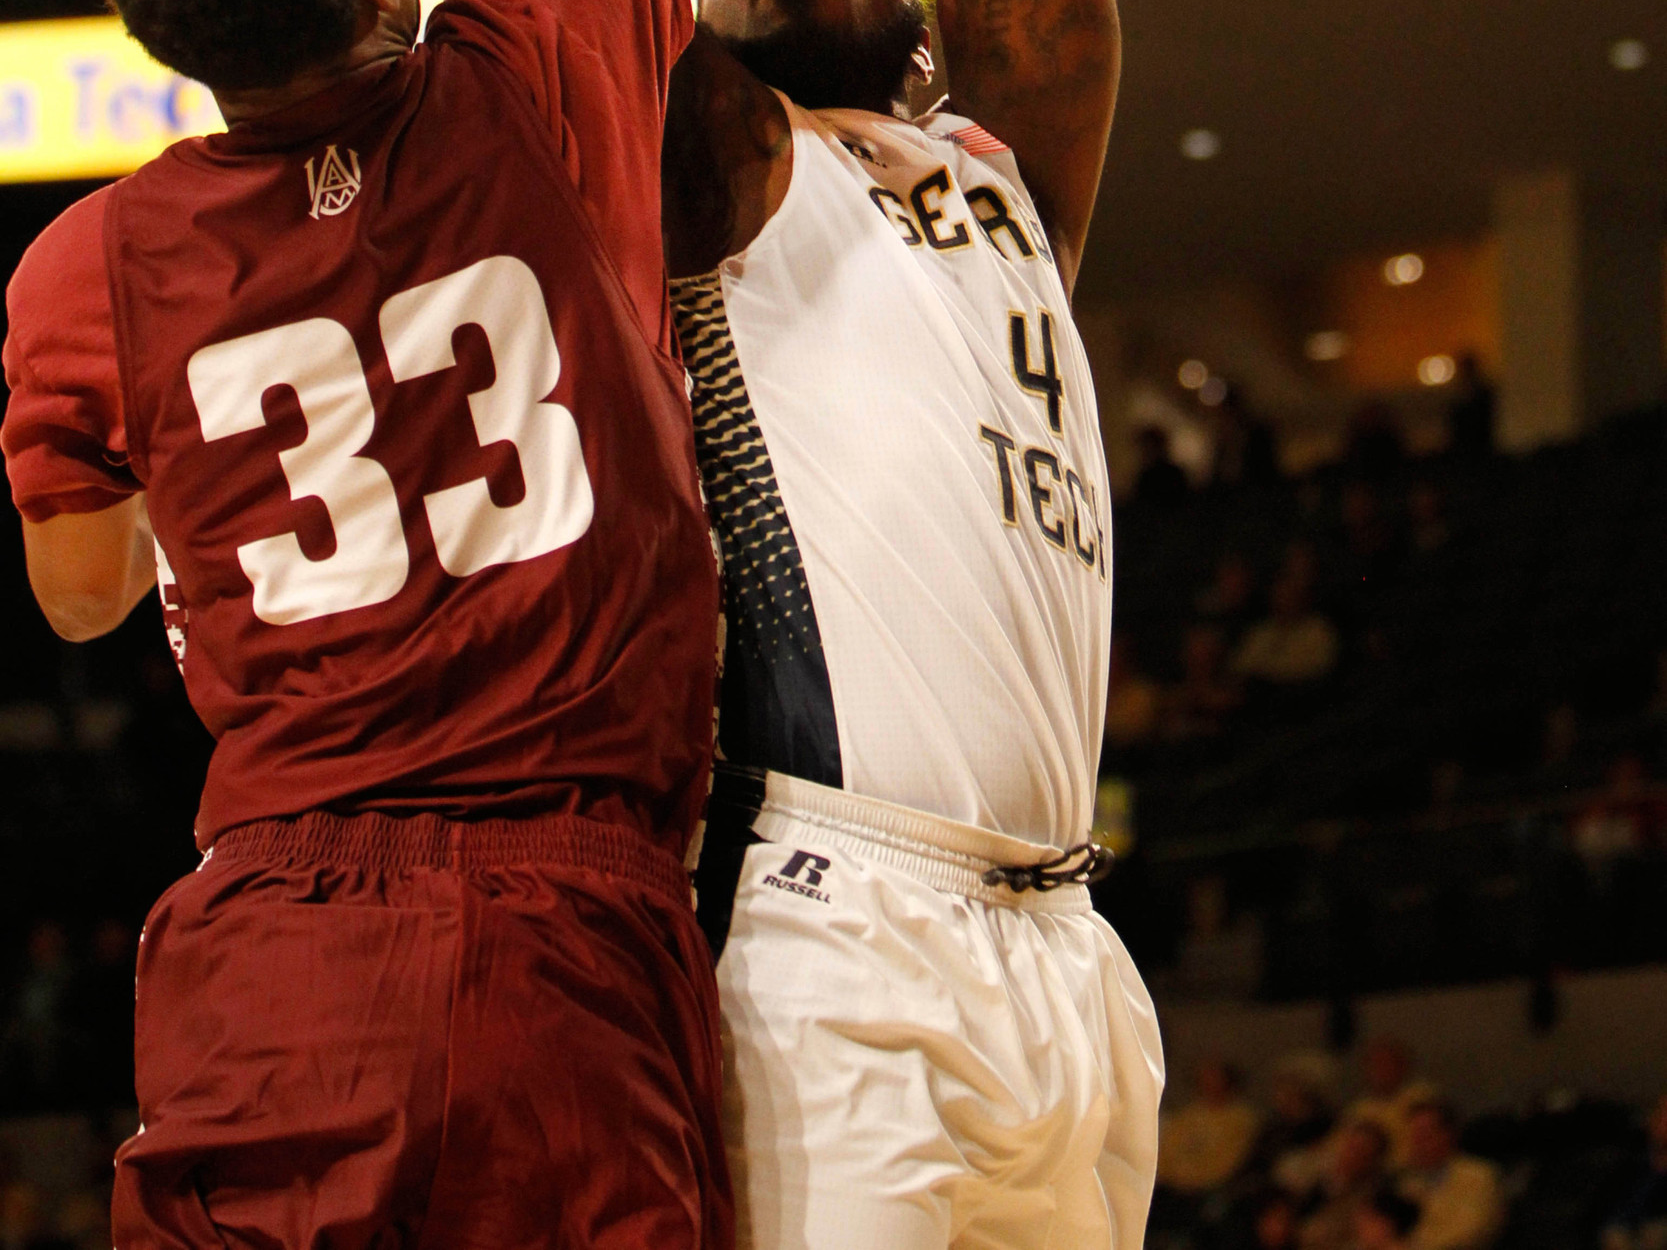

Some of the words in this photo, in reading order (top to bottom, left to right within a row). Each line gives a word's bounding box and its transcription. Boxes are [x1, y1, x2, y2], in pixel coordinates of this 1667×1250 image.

[1008, 307, 1063, 439] 4
[187, 255, 594, 626] 33
[763, 874, 831, 904] RUSSELL
